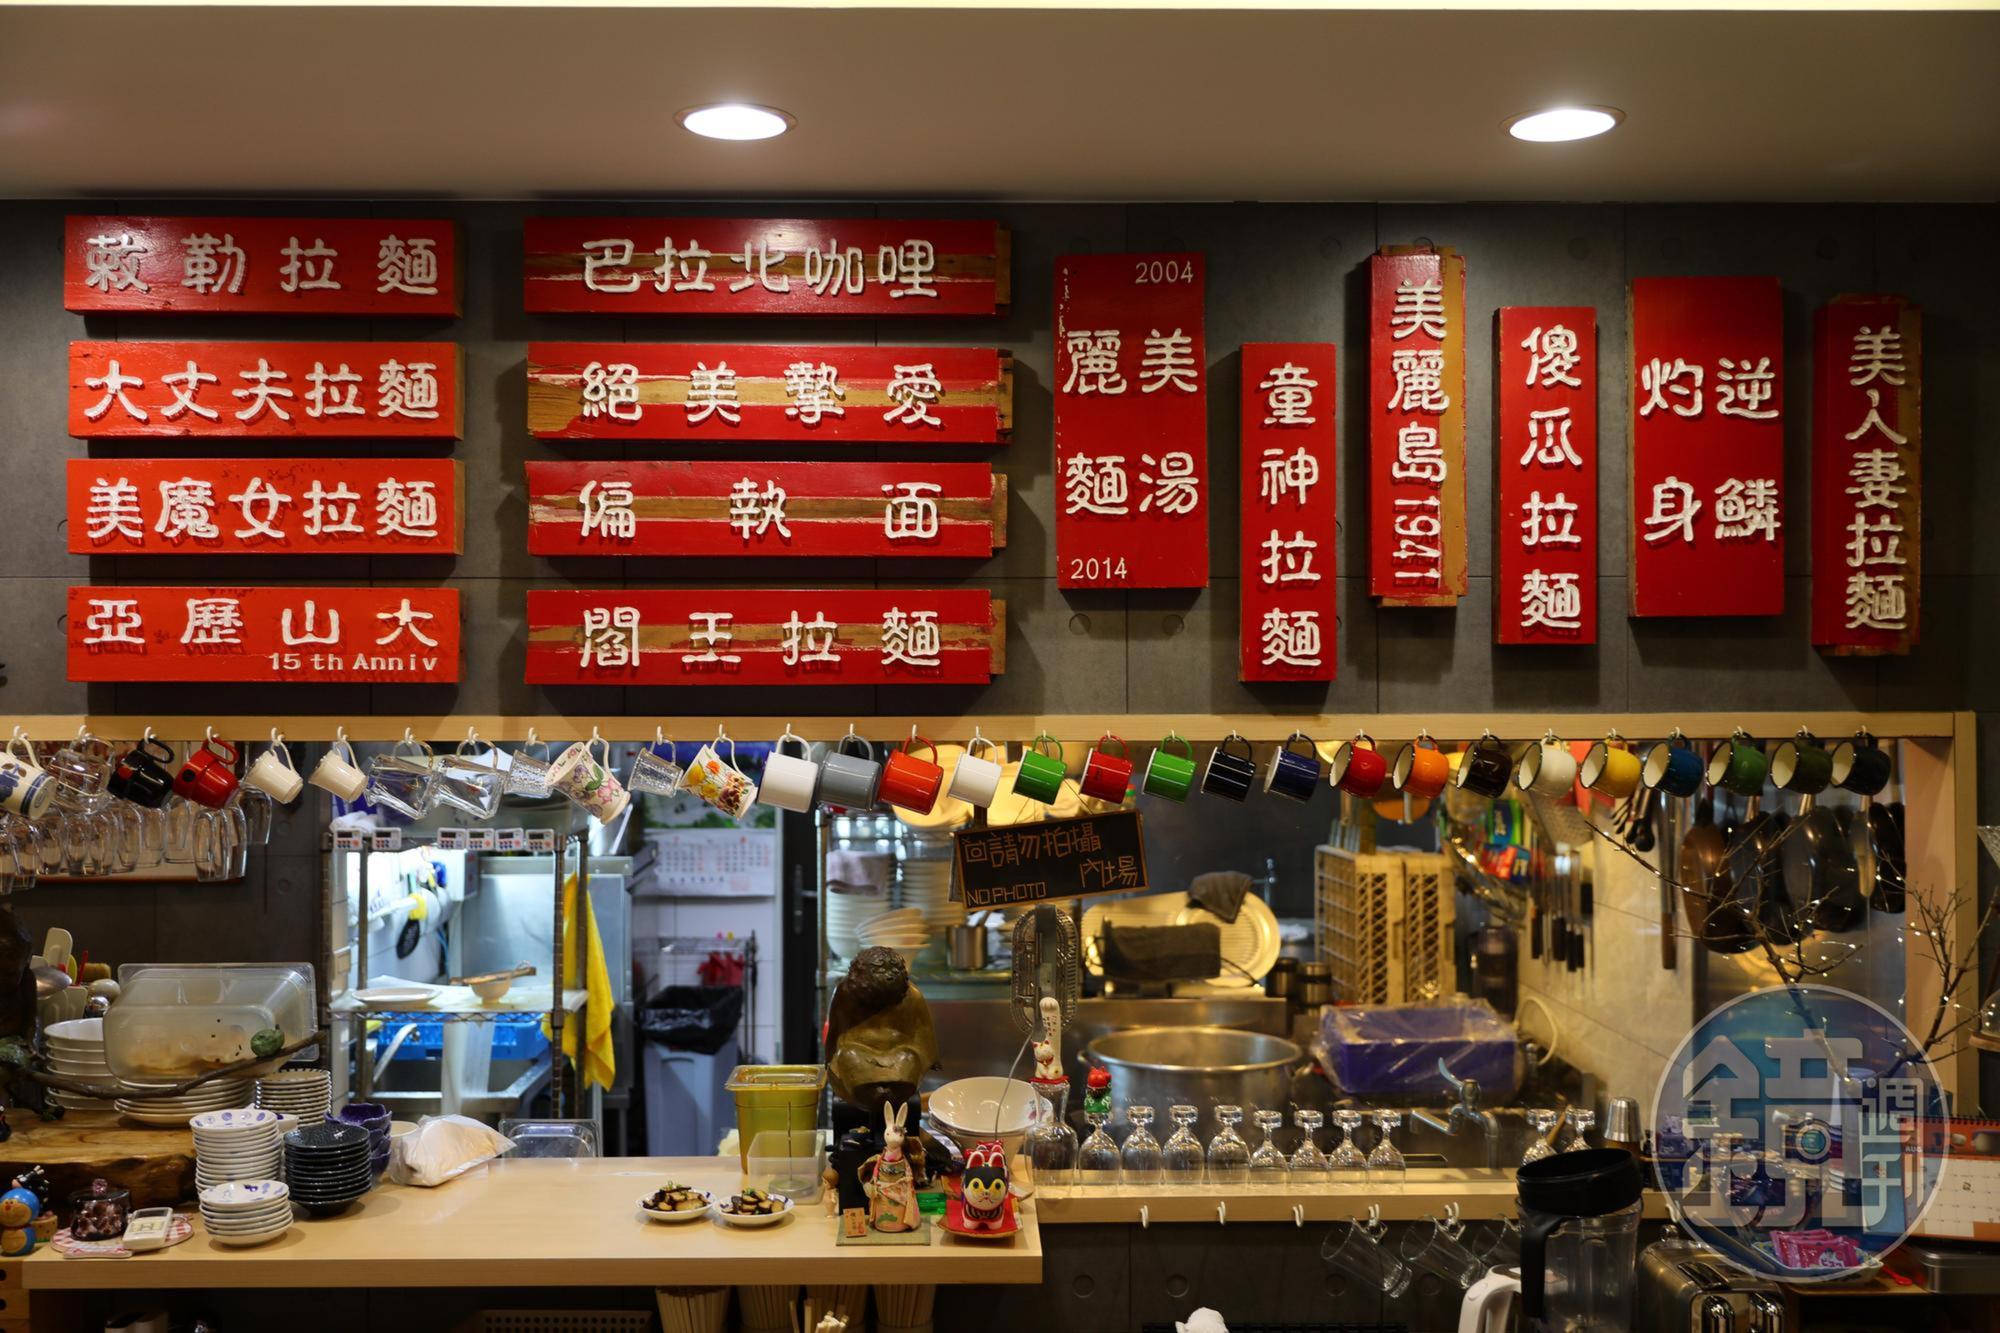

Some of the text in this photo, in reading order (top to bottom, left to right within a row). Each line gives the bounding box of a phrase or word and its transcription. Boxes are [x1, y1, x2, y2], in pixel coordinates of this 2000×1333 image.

[582, 236, 938, 298] 巴拉北咖哩
[1134, 260, 1195, 284] 2004
[84, 358, 439, 421] 大丈夫拉麵
[581, 361, 943, 426] 絕美摯愛
[1520, 324, 1583, 629] 傻瓜拉麵
[1845, 325, 1908, 630] 美人妻拉麵
[86, 477, 438, 539] 美魔女拉麵
[579, 477, 942, 539] 偏執面
[1259, 362, 1322, 667] 童神拉麵
[1070, 556, 1128, 580] 2014
[84, 598, 438, 647] 亞歷山大
[580, 606, 941, 668] 閻王拉麵
[352, 652, 438, 671] Anniv
